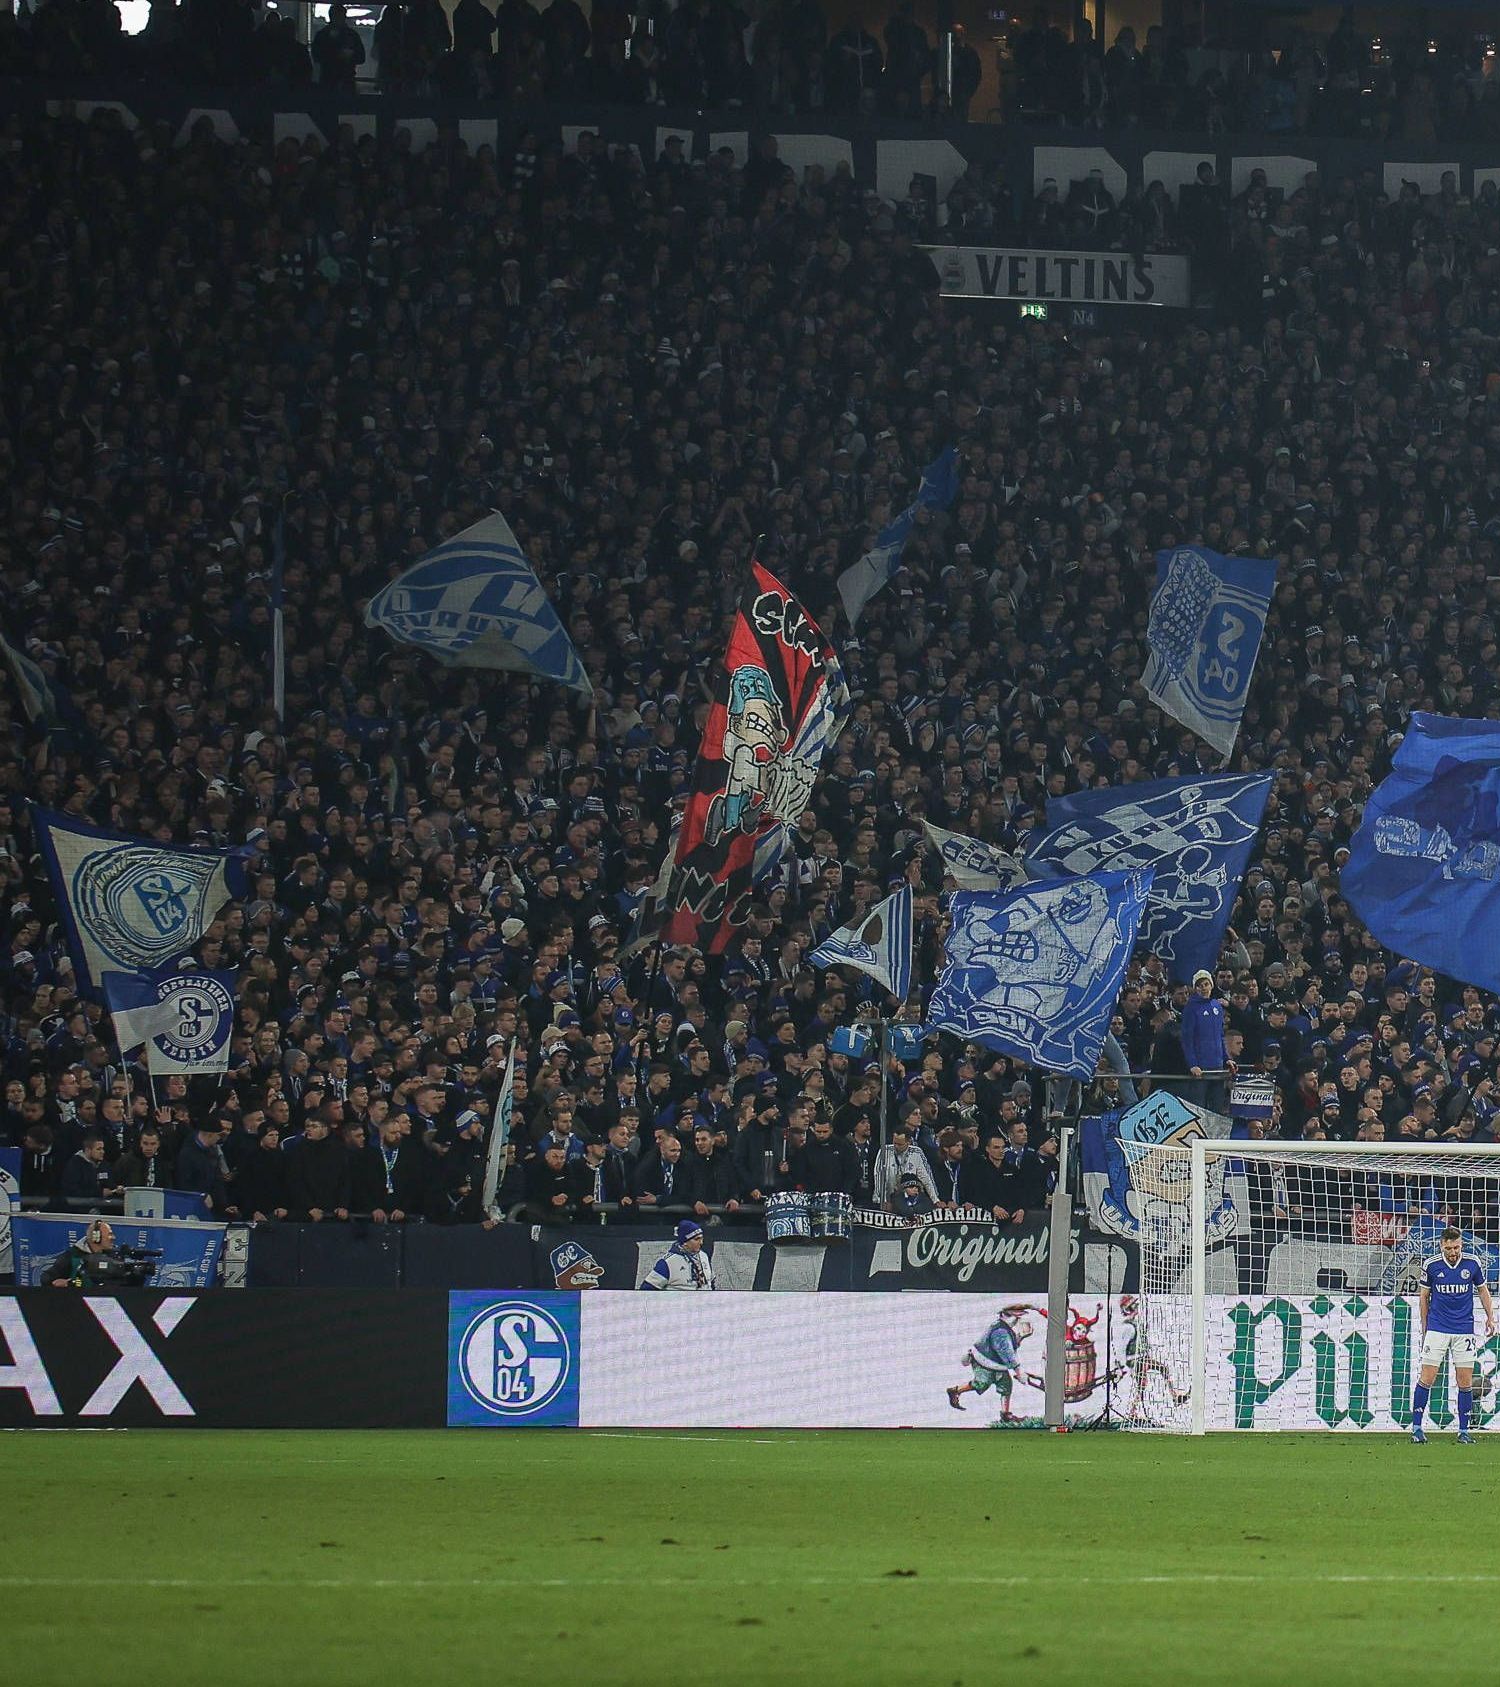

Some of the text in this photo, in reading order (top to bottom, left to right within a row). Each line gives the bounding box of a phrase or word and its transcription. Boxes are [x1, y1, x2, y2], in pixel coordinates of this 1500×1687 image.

[976, 254, 1155, 301] VELTINS
[162, 1040, 217, 1059] VEREIN
[853, 1207, 994, 1227] NUOVA GUARDIA
[907, 1224, 1050, 1282] Original
[1435, 1283, 1469, 1293] VELTINS
[497, 1367, 528, 1401] 04
